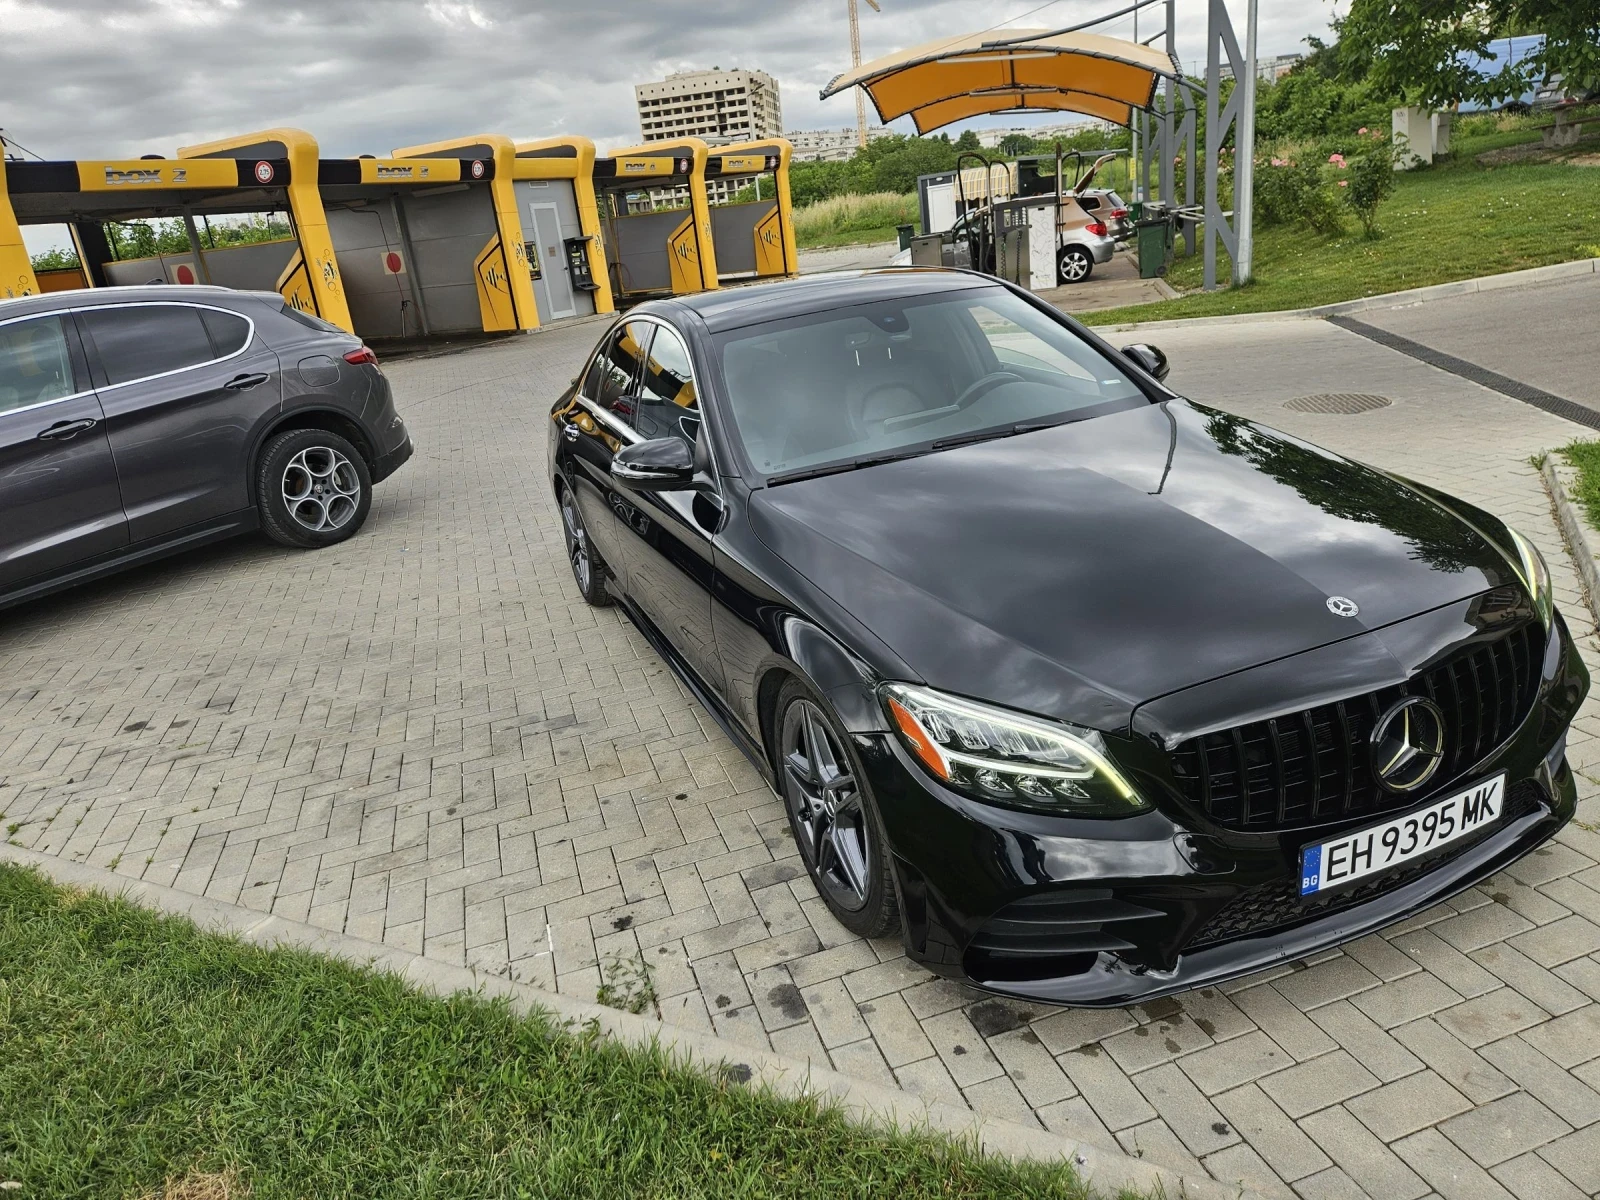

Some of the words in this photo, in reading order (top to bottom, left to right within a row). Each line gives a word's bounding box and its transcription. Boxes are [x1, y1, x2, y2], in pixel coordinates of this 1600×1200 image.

[104, 166, 162, 185] box
[172, 168, 187, 182] 2
[376, 163, 413, 178] box
[1326, 833, 1374, 882] EH
[1381, 801, 1456, 863] 9395
[1460, 781, 1499, 831] MK
[1302, 874, 1319, 889] BG
